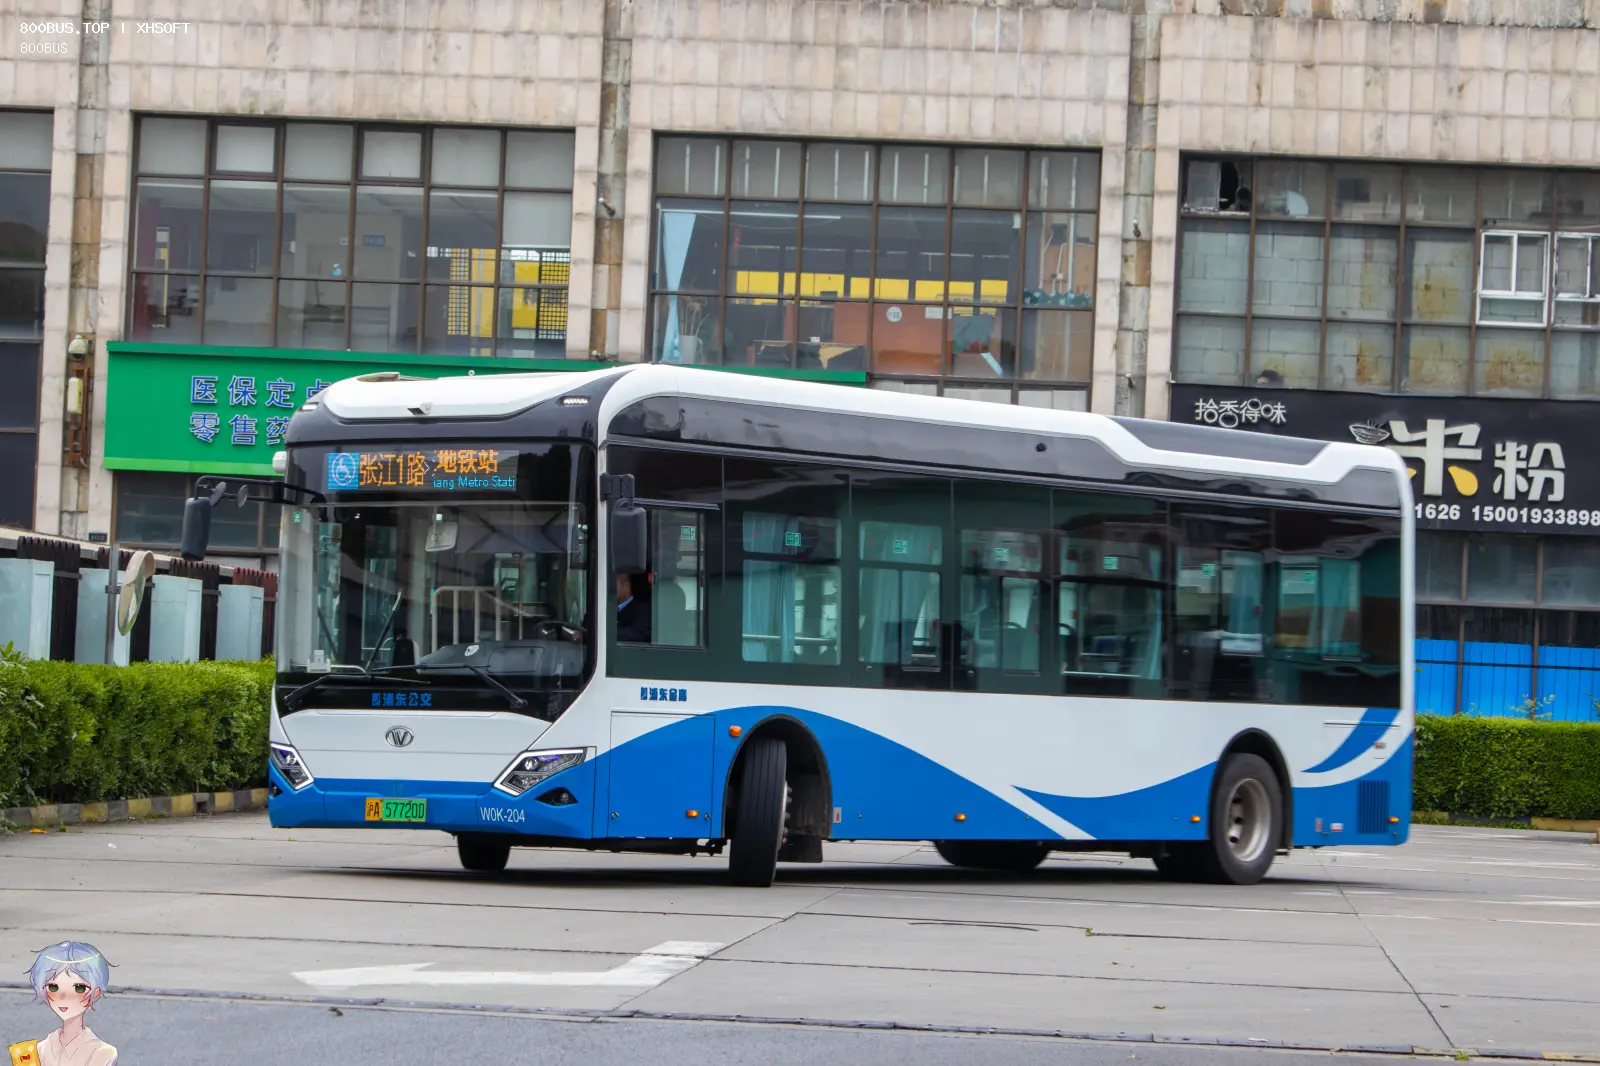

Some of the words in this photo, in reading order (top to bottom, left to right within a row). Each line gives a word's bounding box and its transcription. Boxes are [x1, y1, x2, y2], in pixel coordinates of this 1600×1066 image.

[359, 452, 425, 487] 张江1路
[435, 449, 499, 474] 地铁站
[1385, 418, 1566, 502] 米粉
[457, 476, 489, 488] Metro
[1472, 505, 1600, 526] 15001933898
